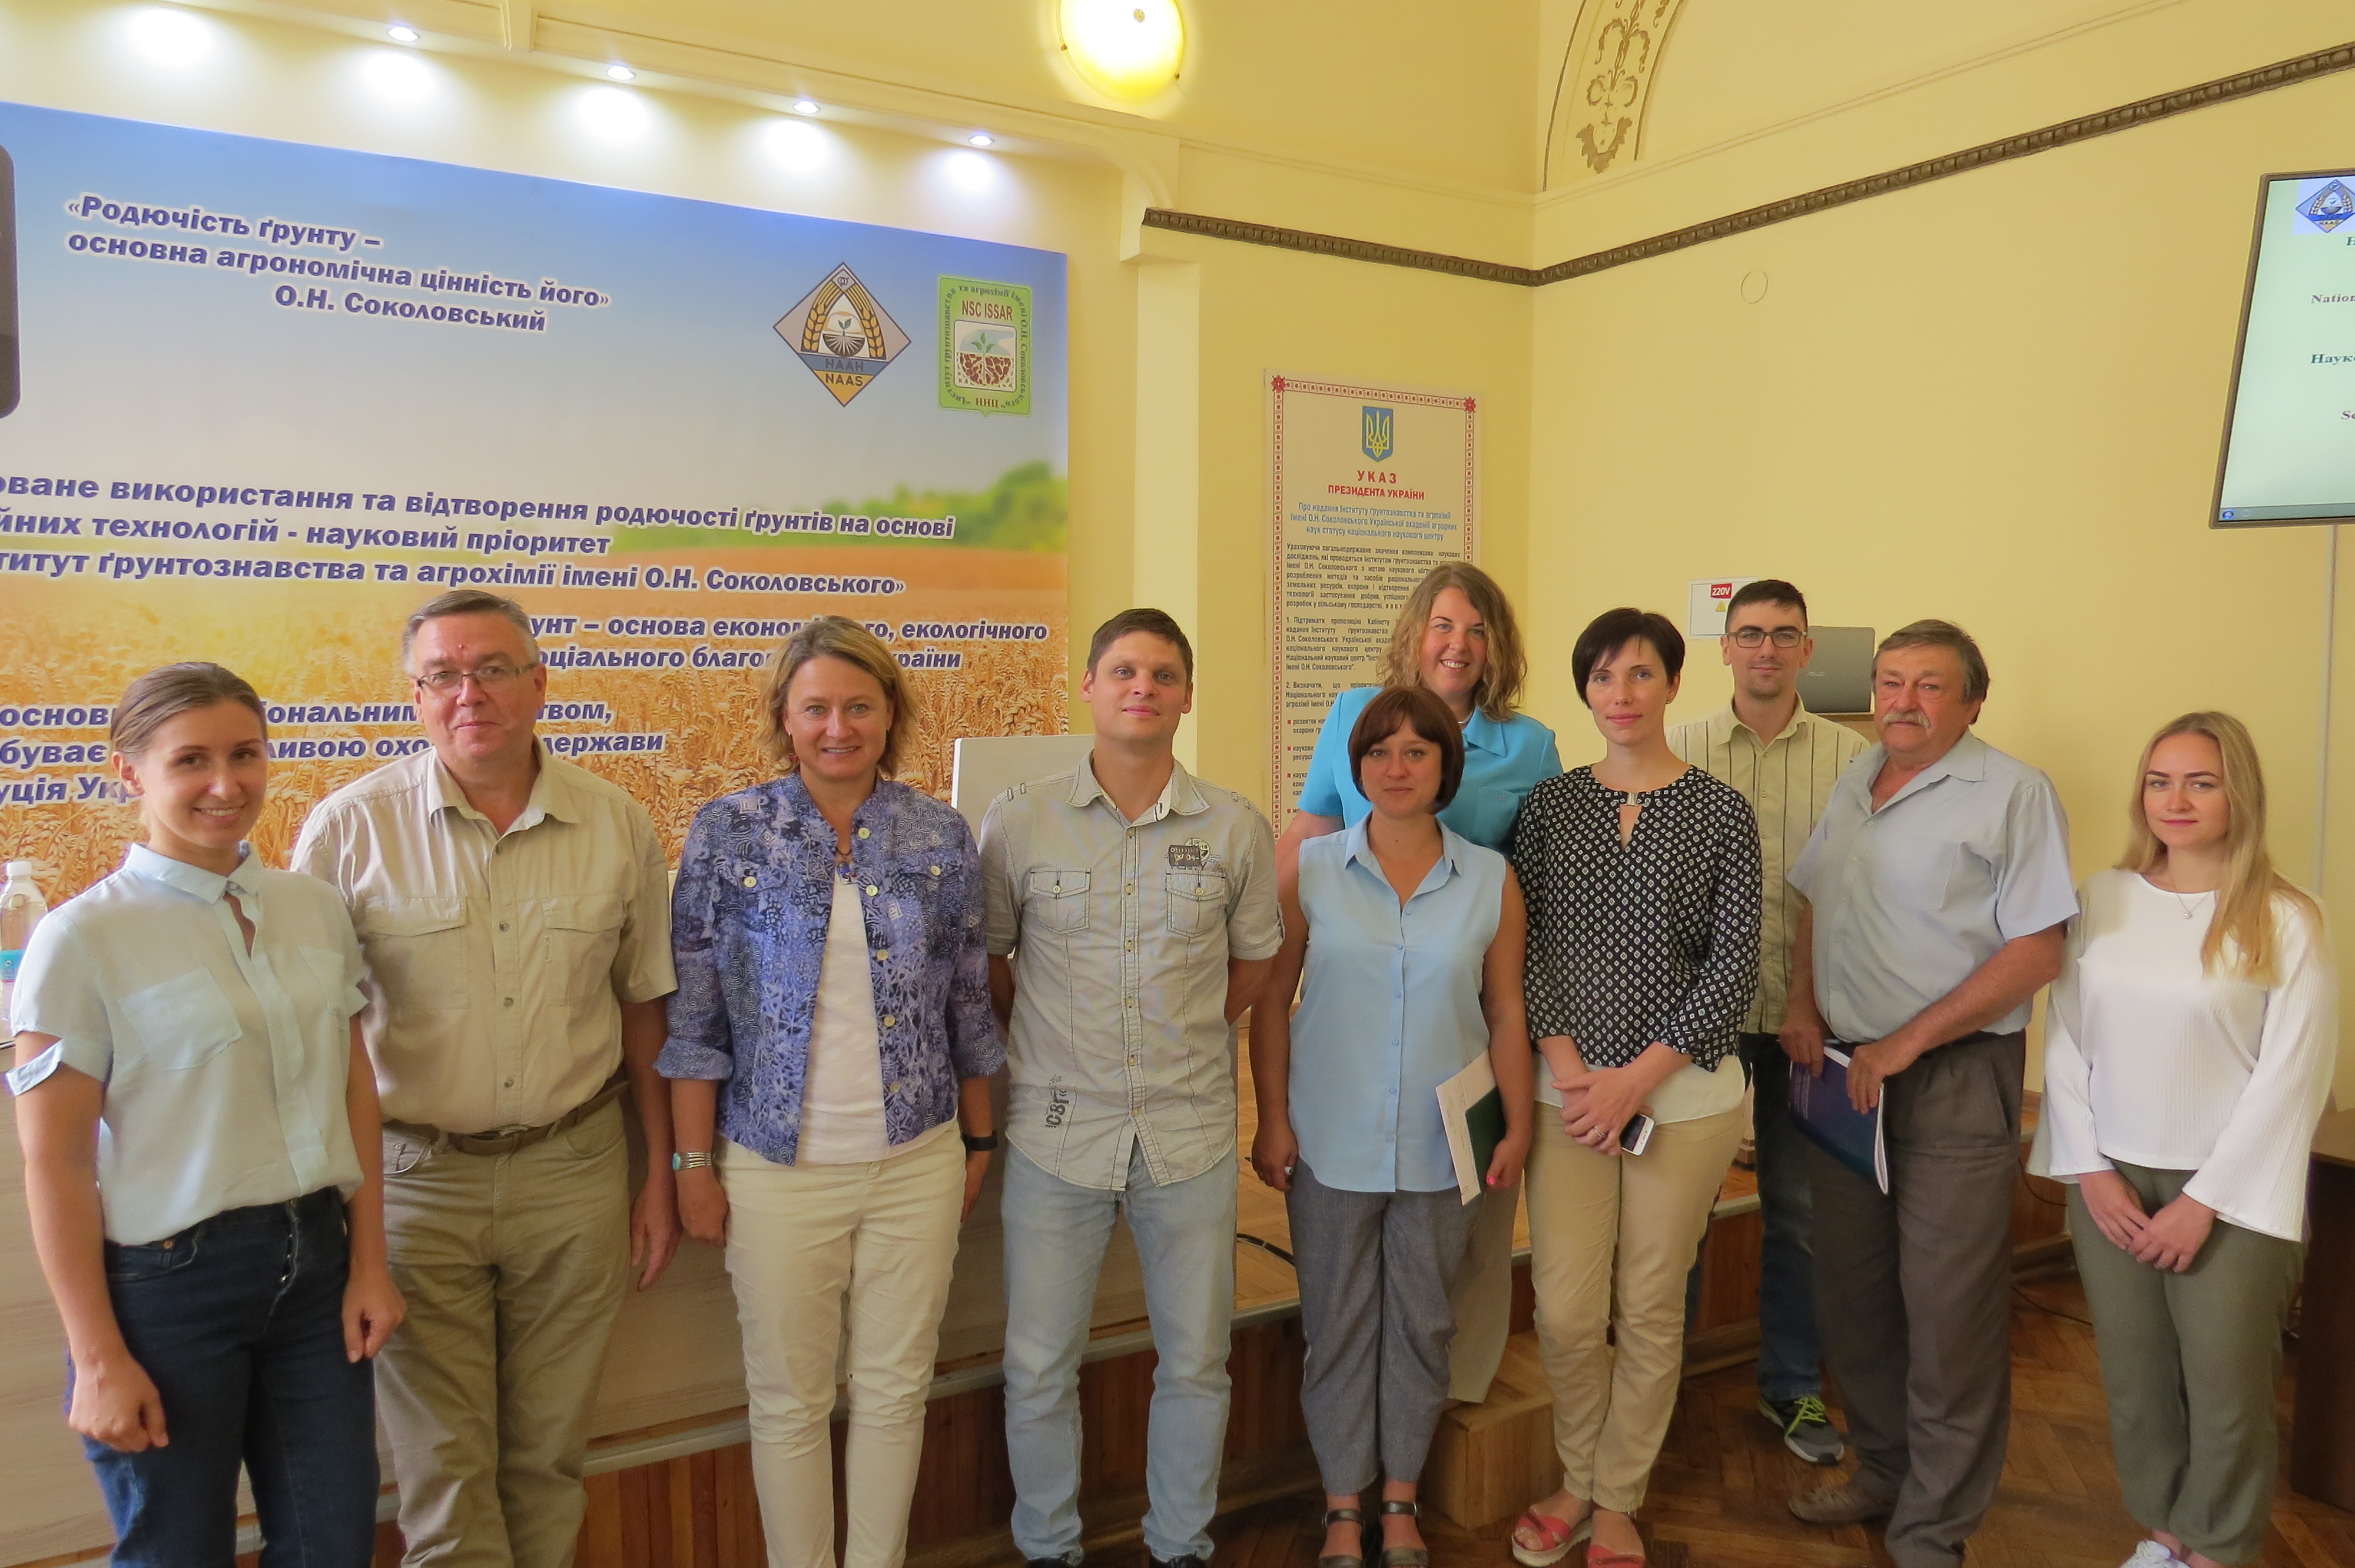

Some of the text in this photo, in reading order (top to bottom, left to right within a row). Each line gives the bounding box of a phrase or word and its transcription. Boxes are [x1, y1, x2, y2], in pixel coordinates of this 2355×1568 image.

[69, 196, 250, 235] «Родючість
[259, 220, 356, 251] ґрунту
[69, 234, 609, 307] основна агрономічна цінність його»
[971, 287, 1009, 297] агрохімії
[275, 285, 545, 331] О.Н. Соколовський
[962, 300, 1013, 321] NSC ISSAR
[825, 358, 864, 372] НААН
[2311, 354, 2355, 365] Наук
[825, 373, 863, 386] NAAS
[1356, 470, 1397, 484] УКАЗ
[1328, 484, 1425, 500] ПРЕЗИДЕНТА УКРАЇНИ
[0, 476, 954, 537] ване використання та відтворення родючості ґрунтів на основі
[1298, 502, 1311, 512] Про
[1312, 504, 1339, 513] надання
[1340, 505, 1368, 516] Інституту
[1370, 508, 1416, 517] ґрунтознавства
[1291, 513, 1306, 521] імені
[1308, 514, 1320, 522] О.Н.
[1322, 515, 1368, 525] Соколовського
[1369, 518, 1404, 527] Української
[92, 518, 278, 542] технологій
[306, 526, 457, 549] науковий
[467, 530, 611, 555] пріоритет
[1306, 527, 1444, 542] наук статусу національного наукового центру
[1286, 543, 1321, 552] Ураховуючи
[1322, 545, 1371, 553] загальнодержавне
[98, 552, 364, 579] ґрунтознавства
[374, 564, 407, 581] та
[417, 563, 556, 586] агрохімії
[563, 565, 638, 587] імені
[646, 567, 698, 589] О.Н.
[708, 570, 905, 595] Соколовського»
[1318, 563, 1358, 571] Соколовського
[1712, 587, 1731, 596] 220V
[1294, 616, 1325, 624] Підтримати
[531, 619, 577, 637] унт
[608, 619, 705, 636] основа
[902, 620, 1047, 640] екологічного
[540, 646, 961, 669] ціального благо раїни
[0, 702, 612, 726] основ ональним твом,
[0, 739, 107, 769] буває
[267, 740, 366, 758] ливою
[376, 740, 430, 756] охо
